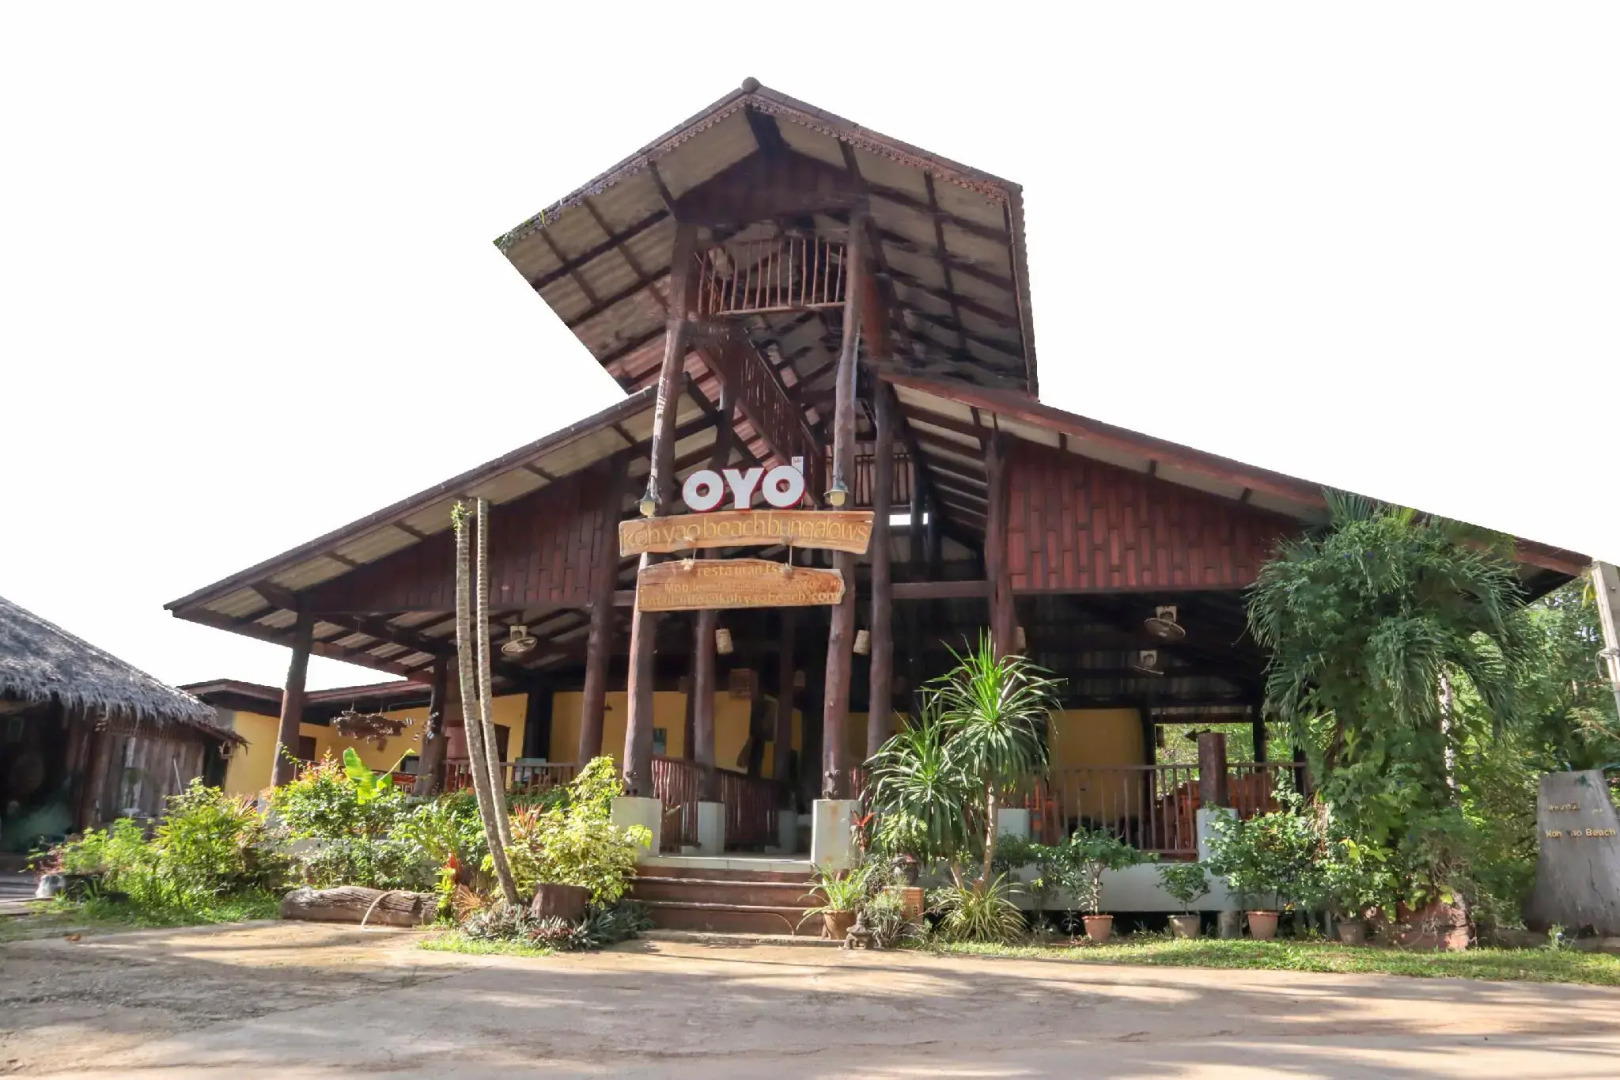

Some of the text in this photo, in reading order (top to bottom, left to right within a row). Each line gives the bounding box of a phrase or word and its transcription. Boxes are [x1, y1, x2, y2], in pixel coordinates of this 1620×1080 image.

[682, 465, 806, 512] OYO
[703, 514, 765, 537] beach
[768, 513, 869, 544] bungalows
[1585, 828, 1616, 837] Beach
